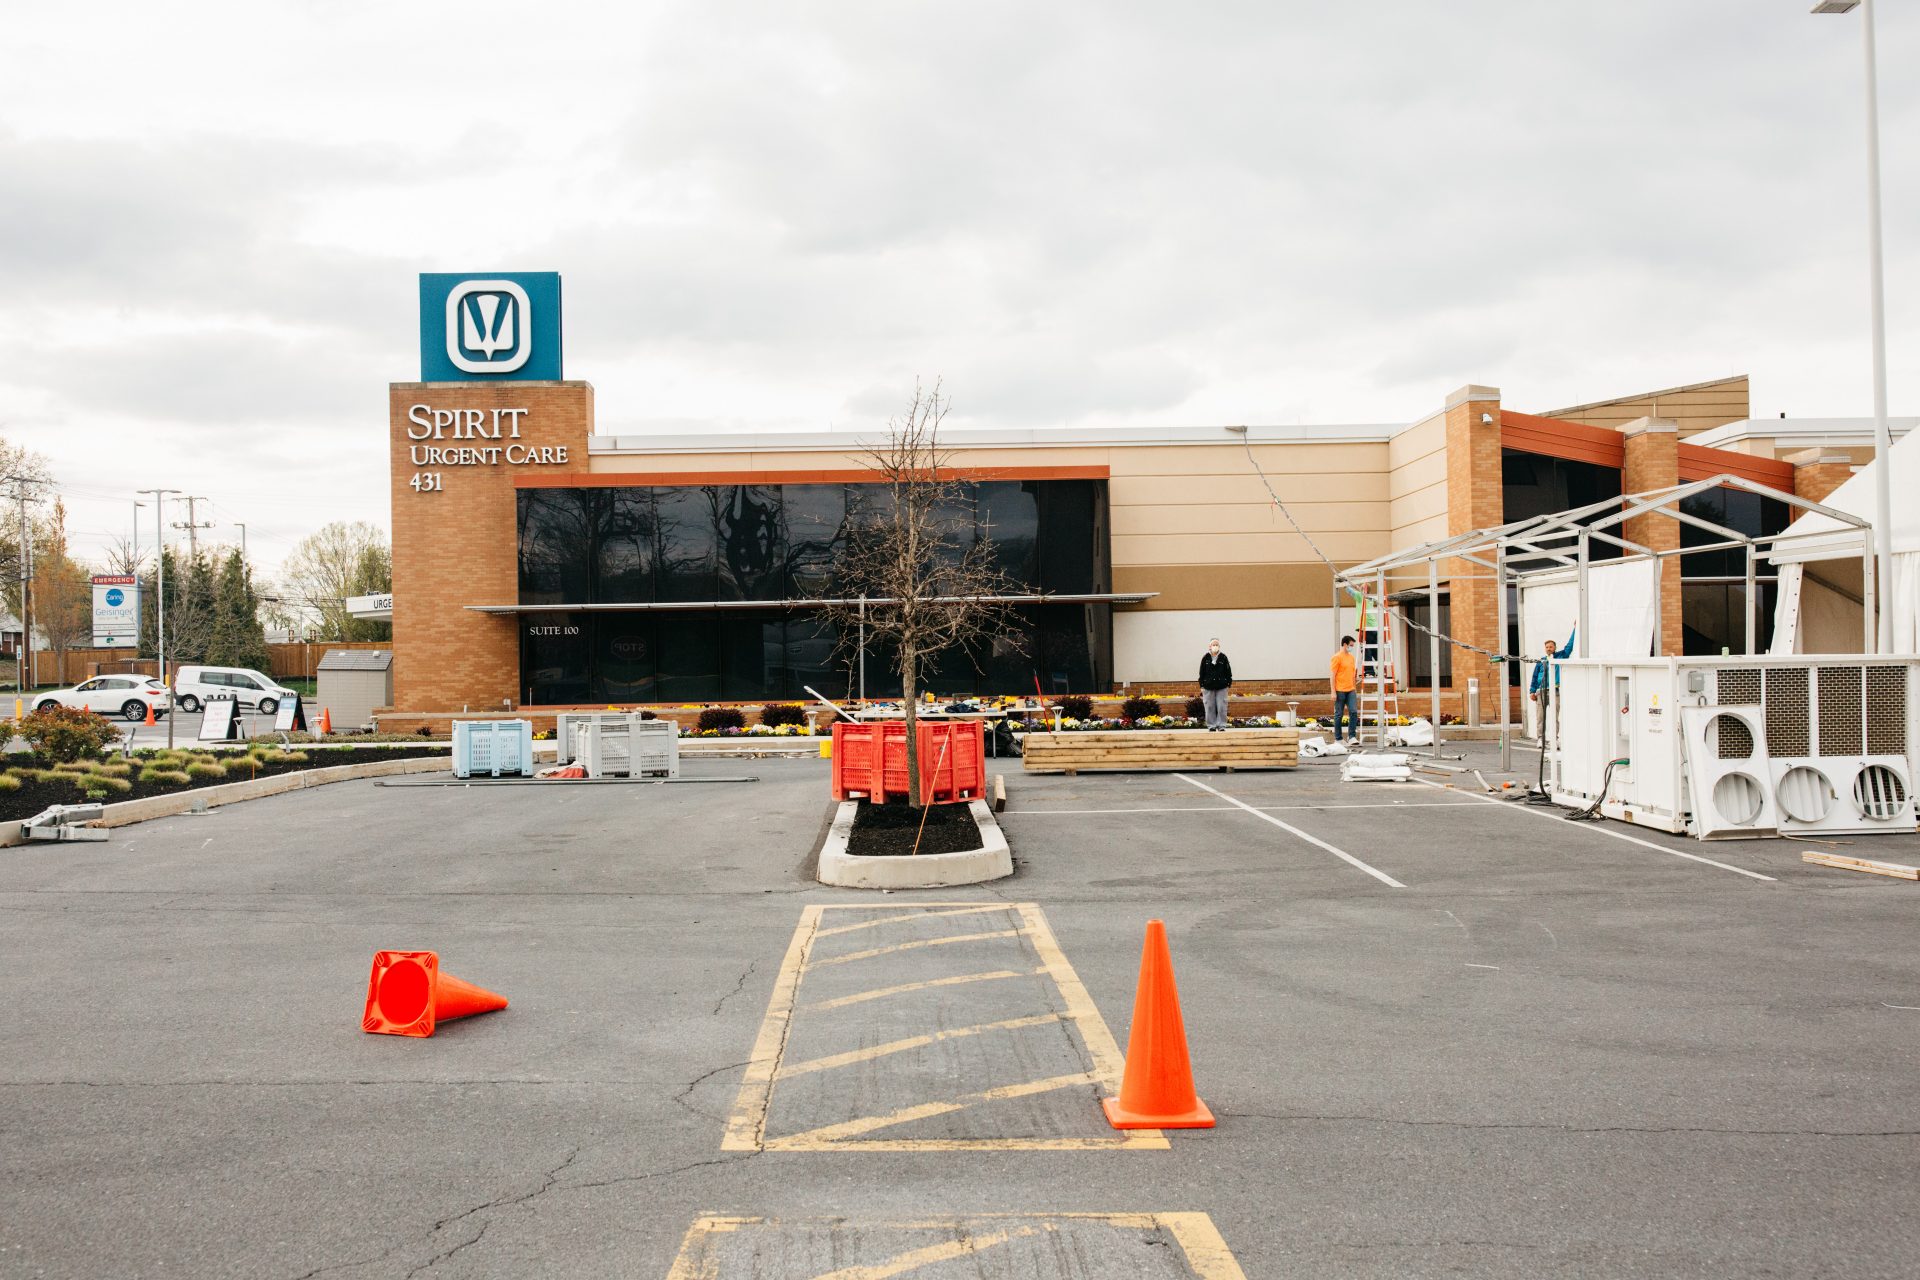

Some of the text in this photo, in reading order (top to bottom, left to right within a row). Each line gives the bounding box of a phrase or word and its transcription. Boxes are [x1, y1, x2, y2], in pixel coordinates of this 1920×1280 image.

[407, 404, 529, 440] SPIRIT
[409, 444, 569, 466] URGENT CARE
[409, 472, 443, 492] 431
[95, 608, 134, 616] Geisinger
[529, 626, 579, 636] SUITE 100
